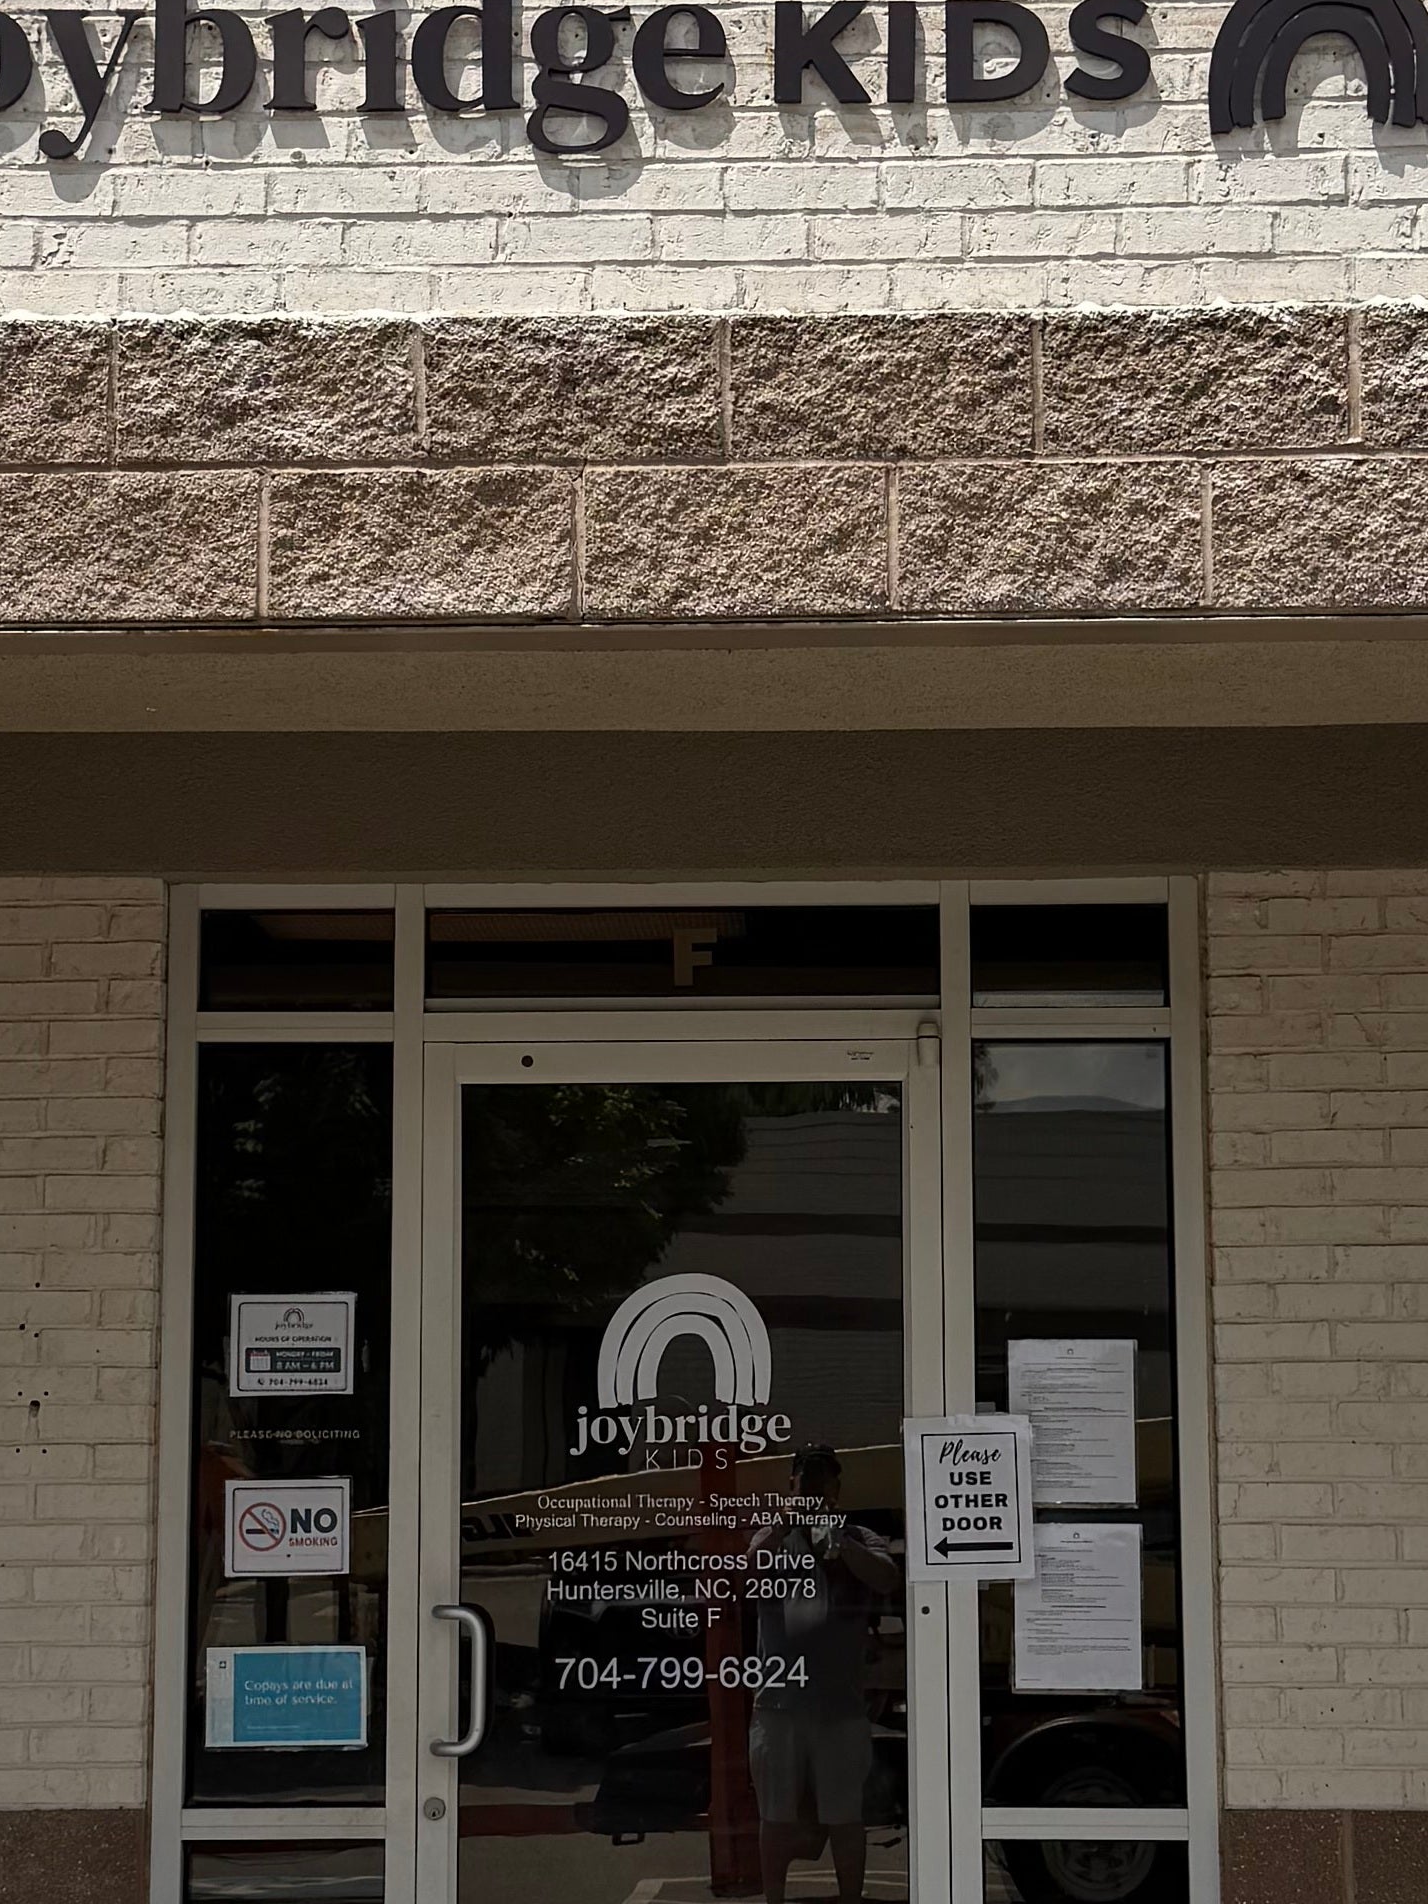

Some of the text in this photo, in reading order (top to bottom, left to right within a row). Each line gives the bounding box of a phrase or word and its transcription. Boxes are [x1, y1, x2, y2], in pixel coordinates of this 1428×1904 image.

[673, 927, 718, 987] F
[275, 1350, 305, 1358] MONDAY
[311, 1350, 334, 1358] FRIDAY
[284, 1361, 301, 1370] AM
[320, 1361, 335, 1369] PM
[229, 1429, 361, 1440] PLEASE NO SOLICITING
[570, 1403, 792, 1456] joybridge
[645, 1448, 728, 1470] KIDS
[938, 1438, 1002, 1466] Please
[949, 1471, 992, 1486] USE
[537, 1494, 632, 1512] Occupational
[636, 1494, 695, 1512] Therapy
[709, 1493, 760, 1511] Speech
[763, 1493, 824, 1511] Therapy
[934, 1493, 1008, 1509] OTHER
[290, 1507, 338, 1534] NO
[515, 1513, 576, 1530] Physical
[581, 1513, 641, 1530] Therapy
[654, 1512, 737, 1529] Counseling
[749, 1512, 783, 1526] ABA
[786, 1511, 847, 1529] Therapy
[942, 1516, 1003, 1531] DOOR
[288, 1536, 338, 1547] SMOKING
[547, 1549, 816, 1572] 16415 Northcross Drive
[547, 1577, 817, 1603] Huntersville, NC, 28078
[640, 1607, 722, 1629] Suite F
[554, 1655, 810, 1690] 704-799-6824
[244, 1679, 354, 1693] Copays are due at
[244, 1694, 338, 1705] time of service.
